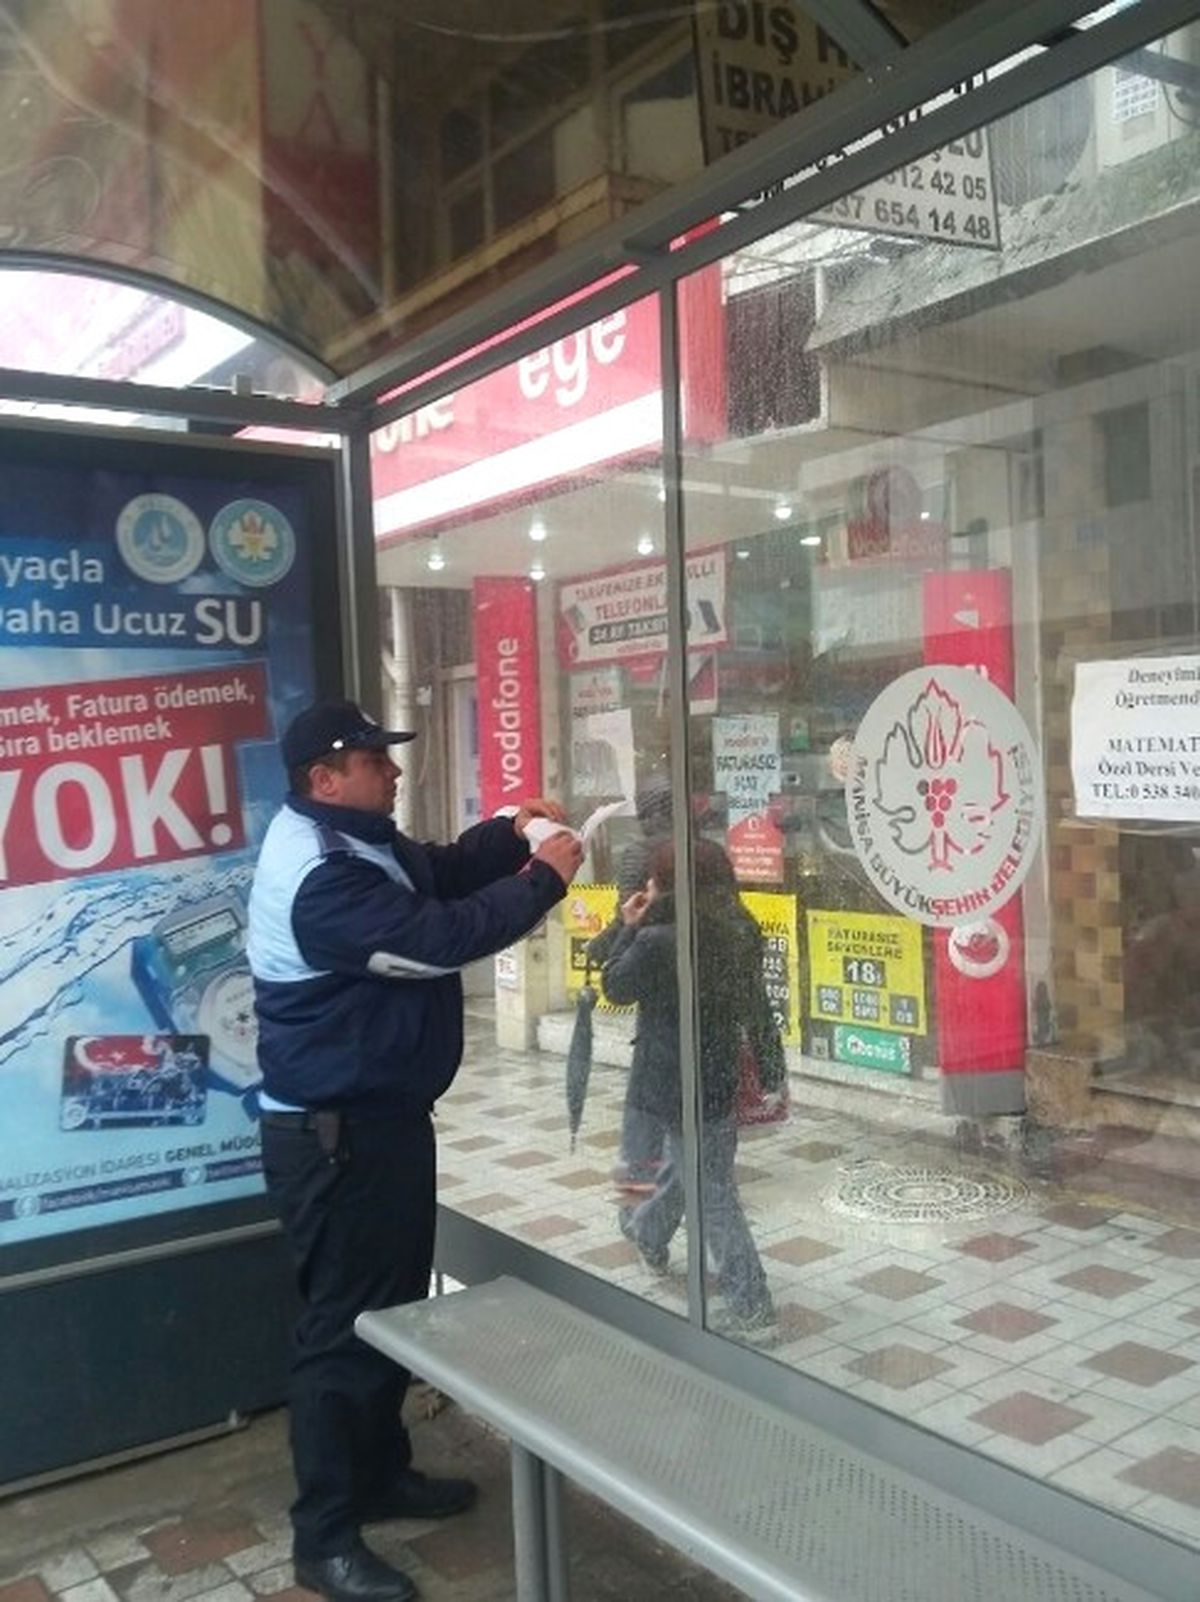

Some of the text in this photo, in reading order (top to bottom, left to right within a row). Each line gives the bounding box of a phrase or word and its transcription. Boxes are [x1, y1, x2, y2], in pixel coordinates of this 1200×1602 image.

[929, 169, 957, 197] 42
[961, 174, 988, 201] 05
[874, 197, 920, 230] 654
[928, 207, 957, 235] 14
[962, 213, 992, 240] 48
[0, 597, 264, 646] aha Ucuz SU
[67, 688, 149, 719] Fatura
[154, 675, 256, 708] ödemek,
[492, 637, 524, 793] vodafone
[47, 714, 173, 755] beklemek
